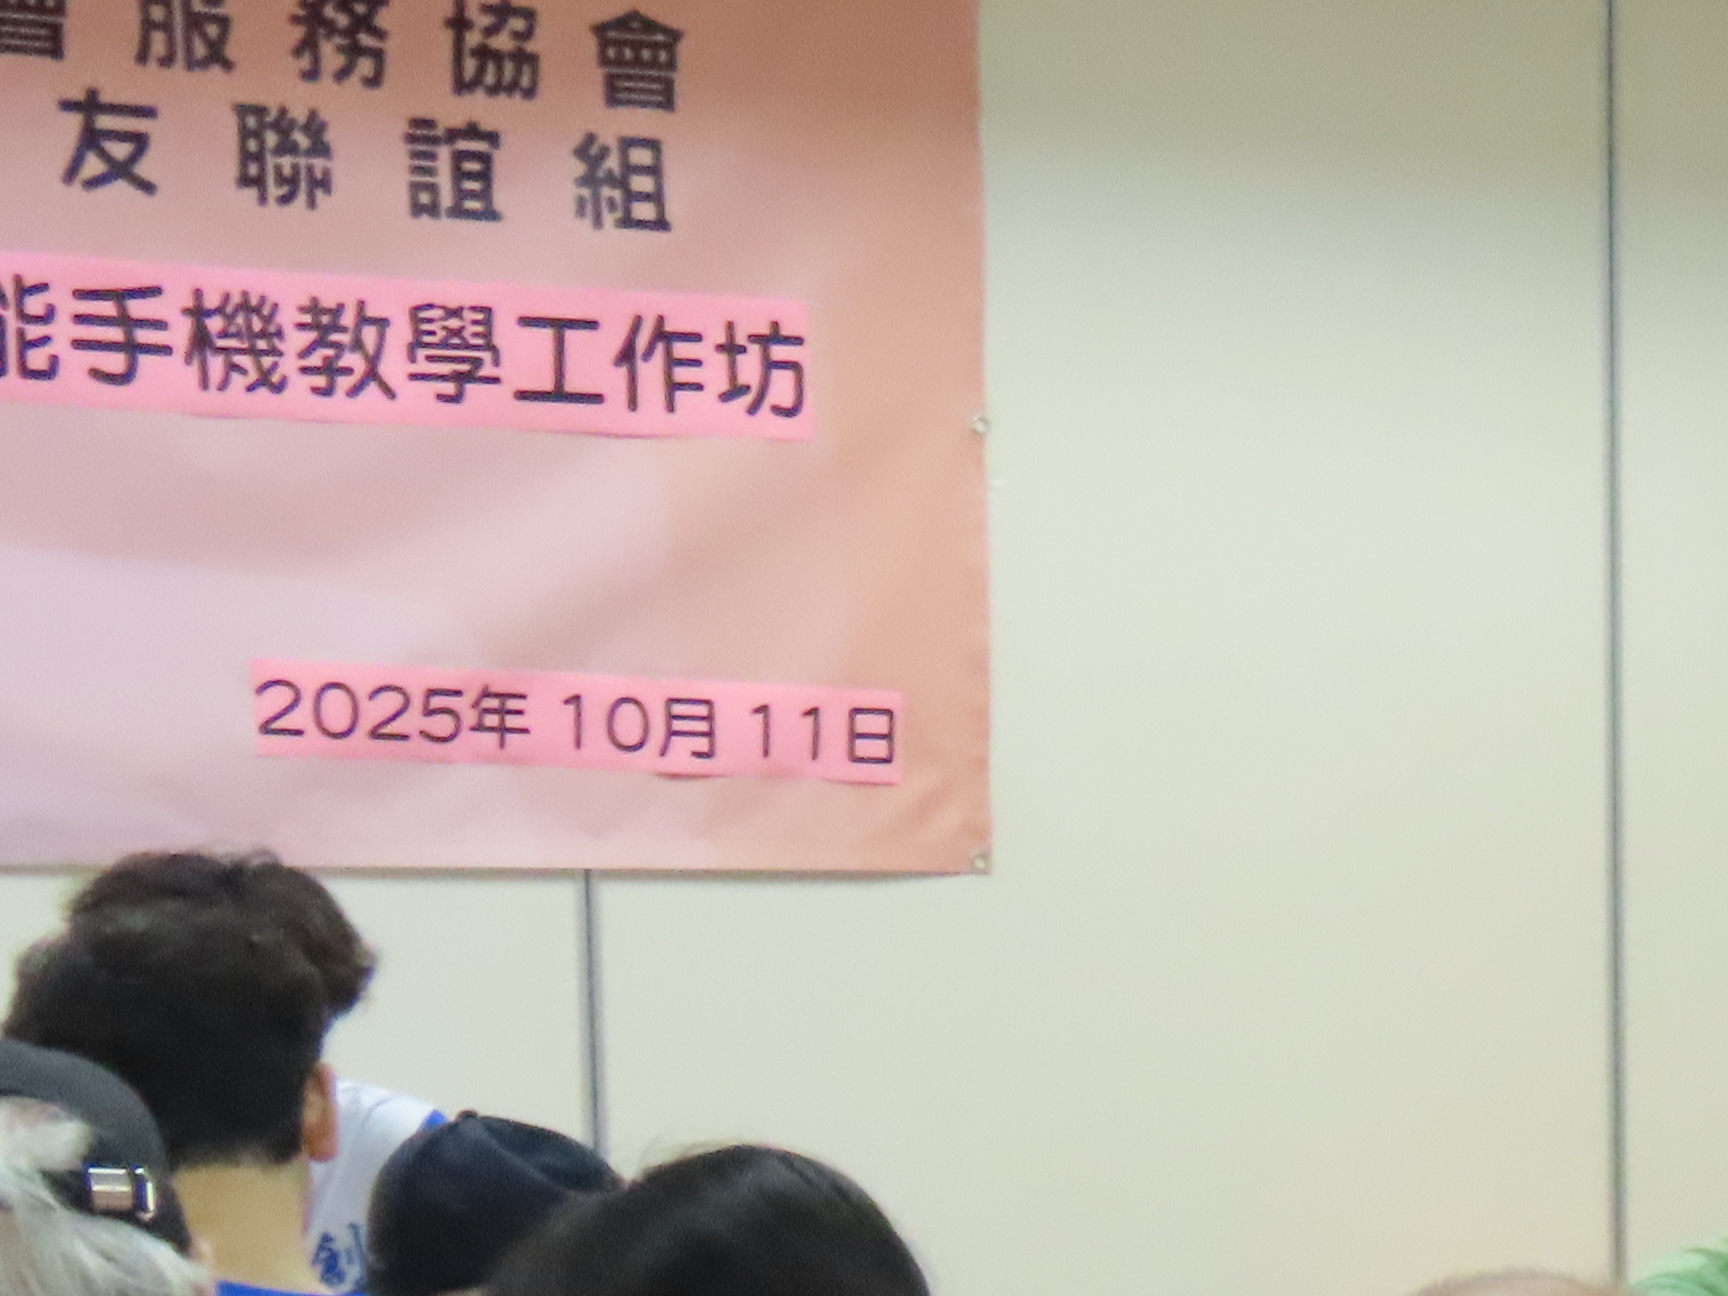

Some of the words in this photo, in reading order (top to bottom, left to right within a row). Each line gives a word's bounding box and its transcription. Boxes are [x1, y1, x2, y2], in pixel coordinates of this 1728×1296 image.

[58, 88, 671, 232] 友聯誼組
[255, 679, 530, 750] 2025年
[562, 694, 717, 760] 10月
[751, 703, 894, 765] 11日
